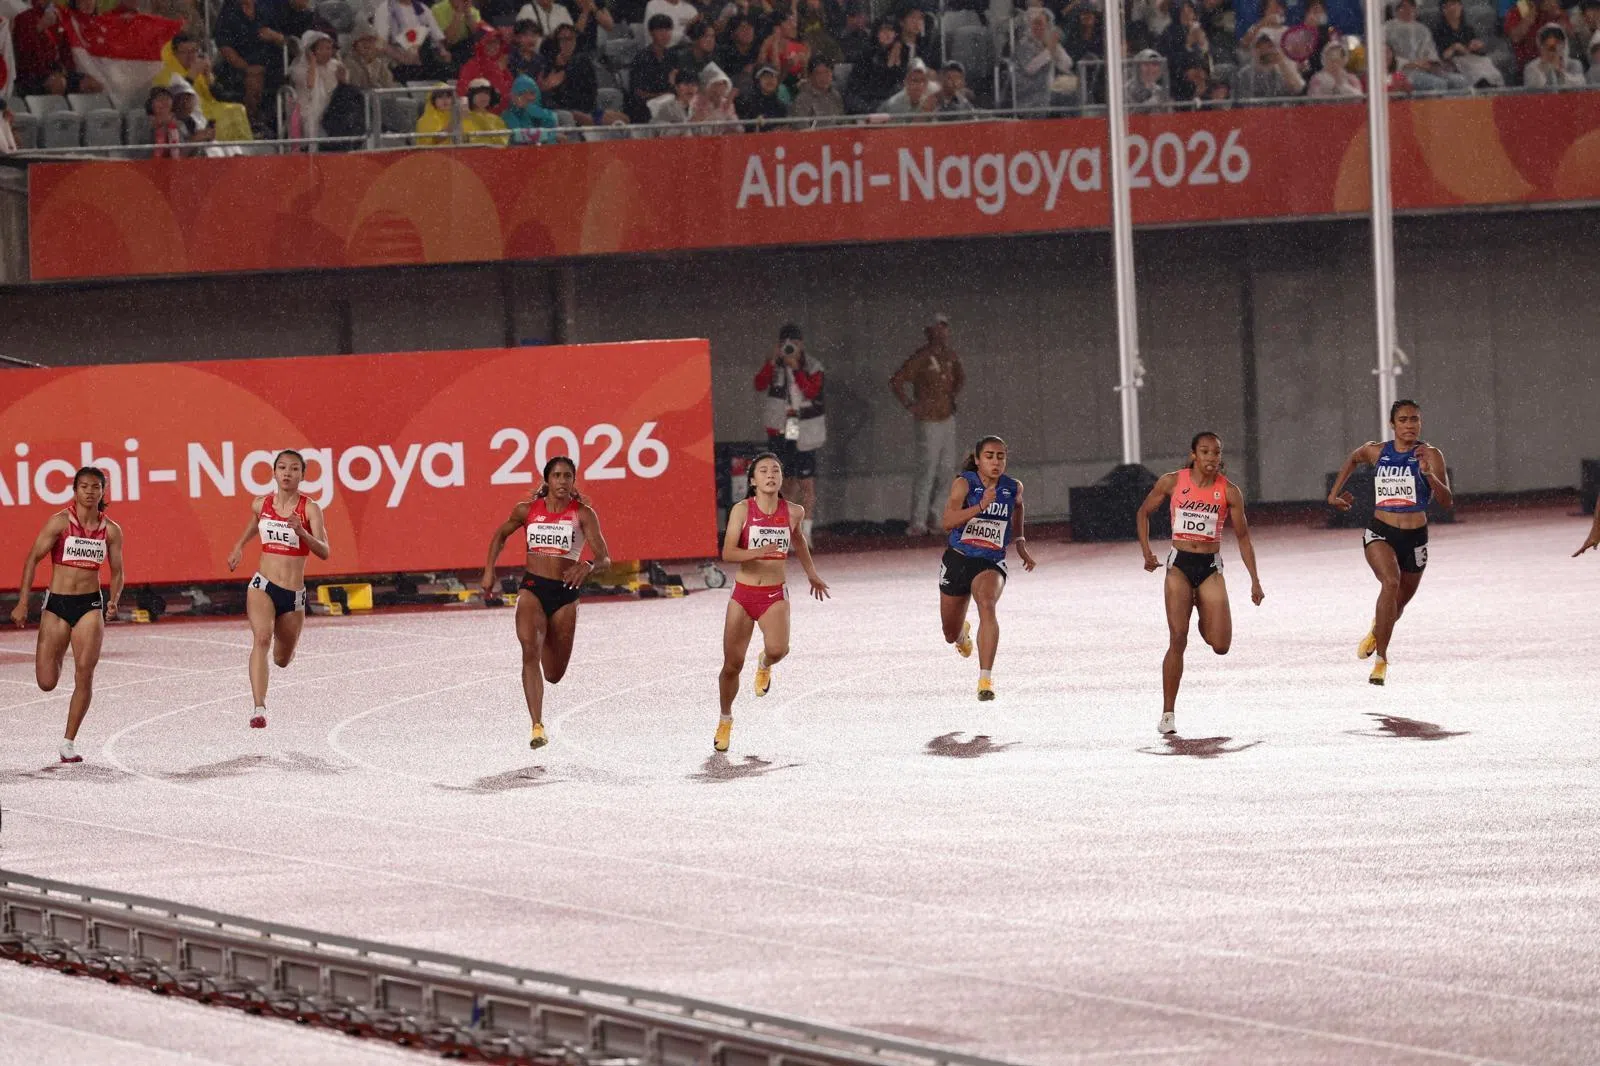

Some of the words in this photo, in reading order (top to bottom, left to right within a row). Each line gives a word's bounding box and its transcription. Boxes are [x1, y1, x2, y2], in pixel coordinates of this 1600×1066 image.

[736, 142, 1101, 214] Aichi-Nagoya
[1122, 128, 1250, 188] 2026
[490, 422, 669, 485] 2026
[1377, 465, 1412, 477] INDIA
[1378, 486, 1413, 496] BOLLAND
[980, 502, 1009, 517] NDIA
[1180, 500, 1220, 513] JAPAN
[1183, 512, 1210, 520] BORNAN
[1183, 521, 1206, 531] IDO
[267, 530, 289, 542] T.LE
[530, 533, 569, 545] PEREIRA
[966, 525, 1001, 541] BHADRA
[66, 546, 104, 559] KHANONTA
[252, 576, 261, 588] 8
